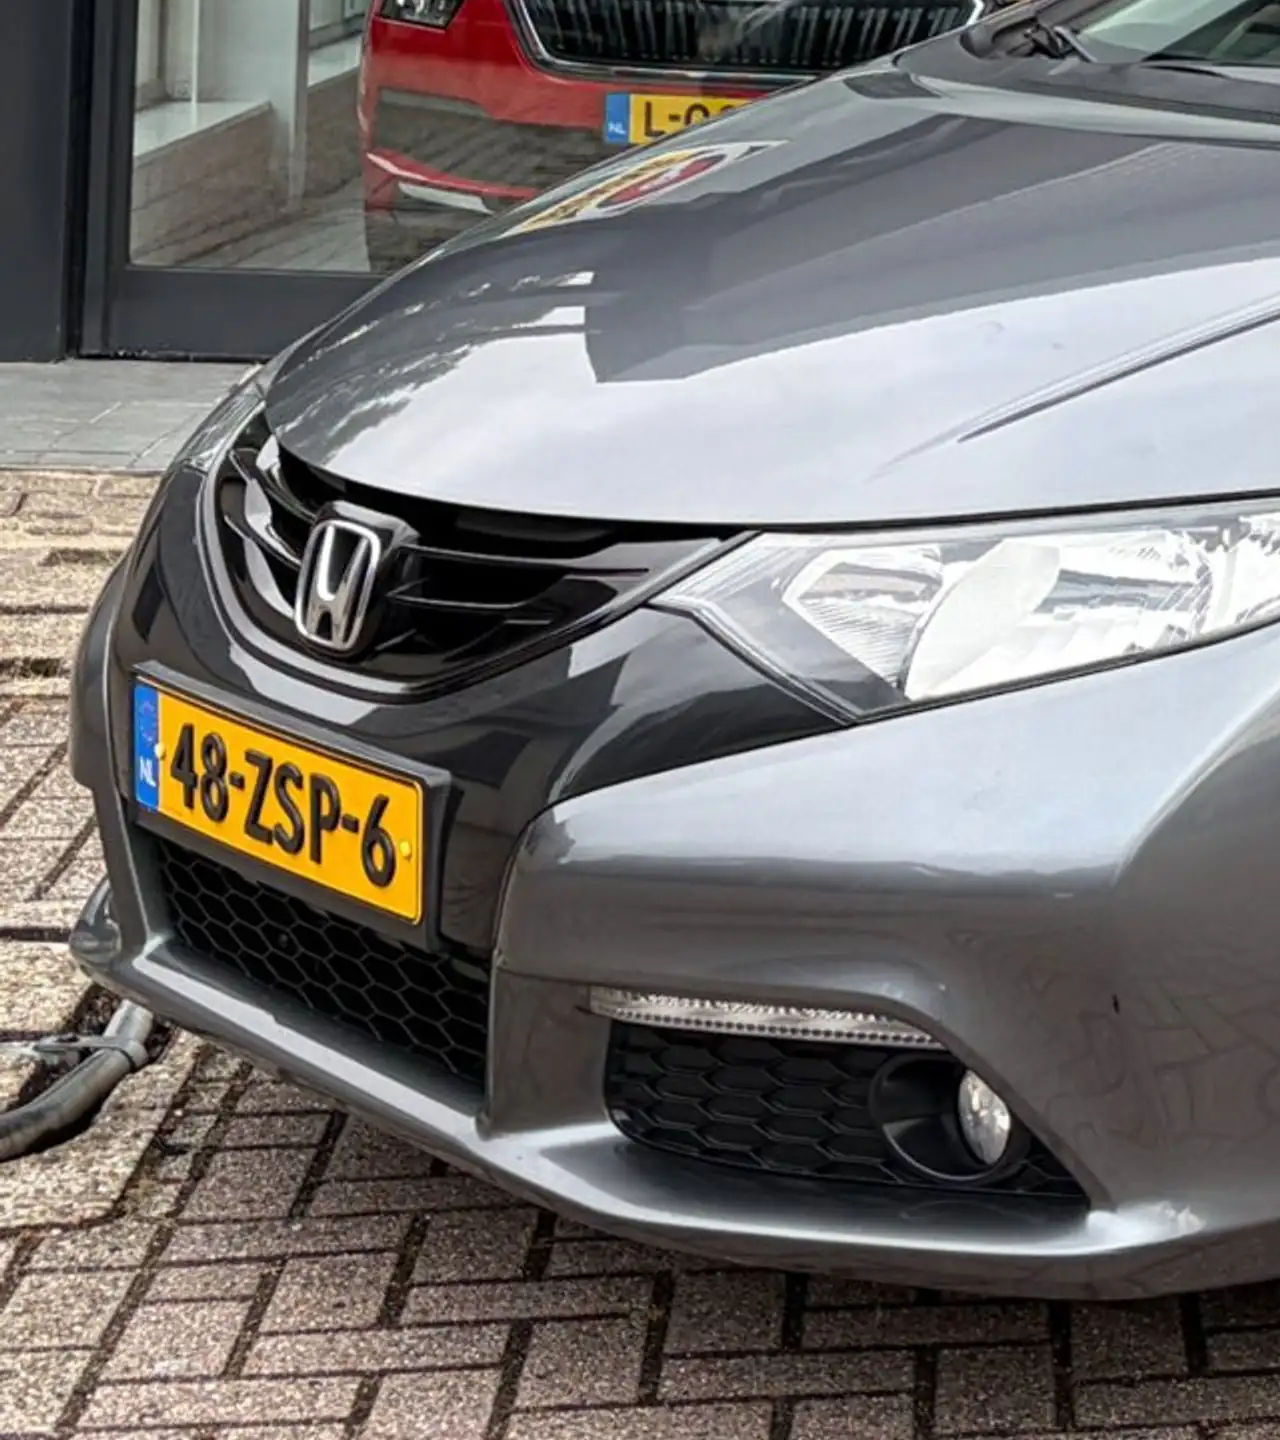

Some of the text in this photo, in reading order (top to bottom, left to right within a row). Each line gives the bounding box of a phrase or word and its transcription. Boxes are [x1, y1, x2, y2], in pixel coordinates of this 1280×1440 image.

[607, 121, 627, 136] NL
[139, 757, 157, 788] NL
[169, 722, 398, 889] 48-ZSP-6
